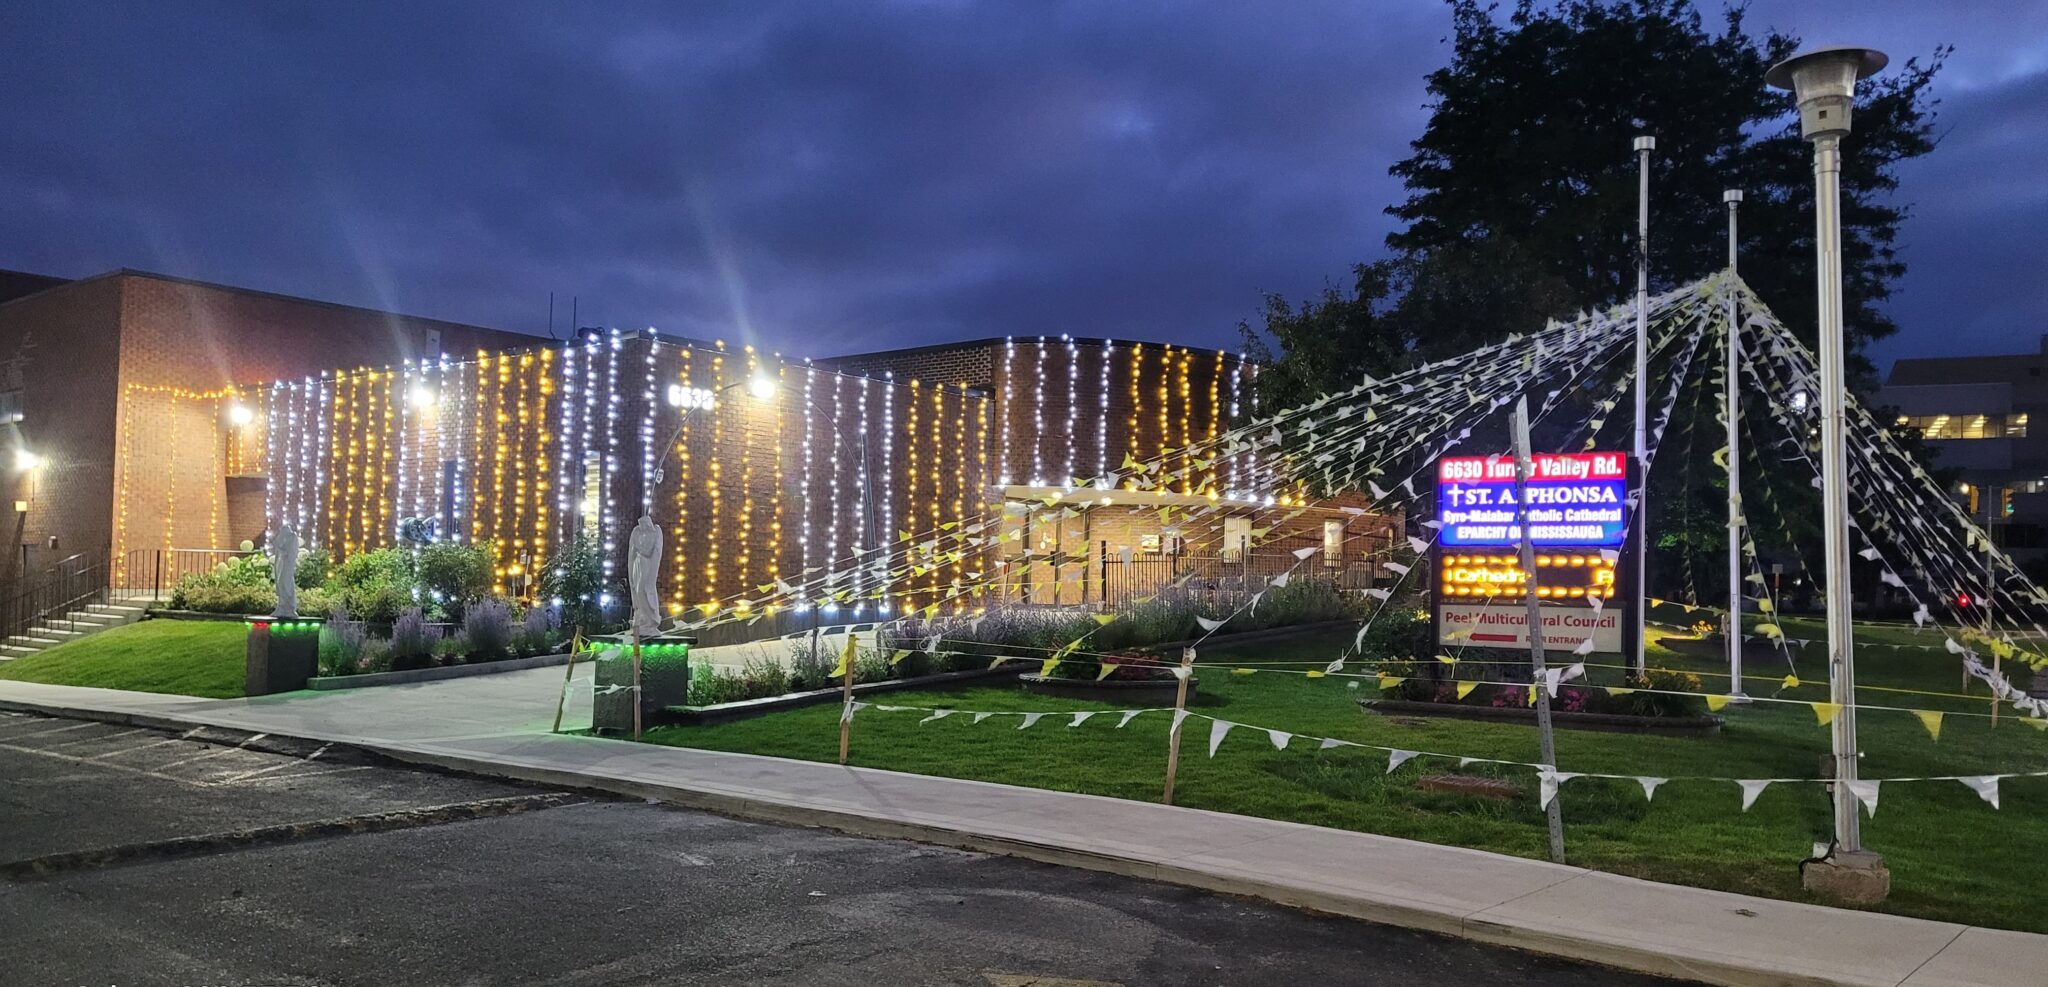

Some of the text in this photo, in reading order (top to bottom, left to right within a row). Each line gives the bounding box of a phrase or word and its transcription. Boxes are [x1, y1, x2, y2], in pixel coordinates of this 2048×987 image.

[1444, 461, 1482, 479] 6630
[1540, 459, 1590, 479] Valley
[1594, 456, 1622, 475] Rd.
[1465, 486, 1617, 505] ST. APHONSA
[1443, 510, 1515, 525] Syro-Malabar
[1565, 507, 1622, 522] Cathedral
[1457, 526, 1507, 539] EPARCHY
[1445, 612, 1616, 628] Peel Multiculral Council
